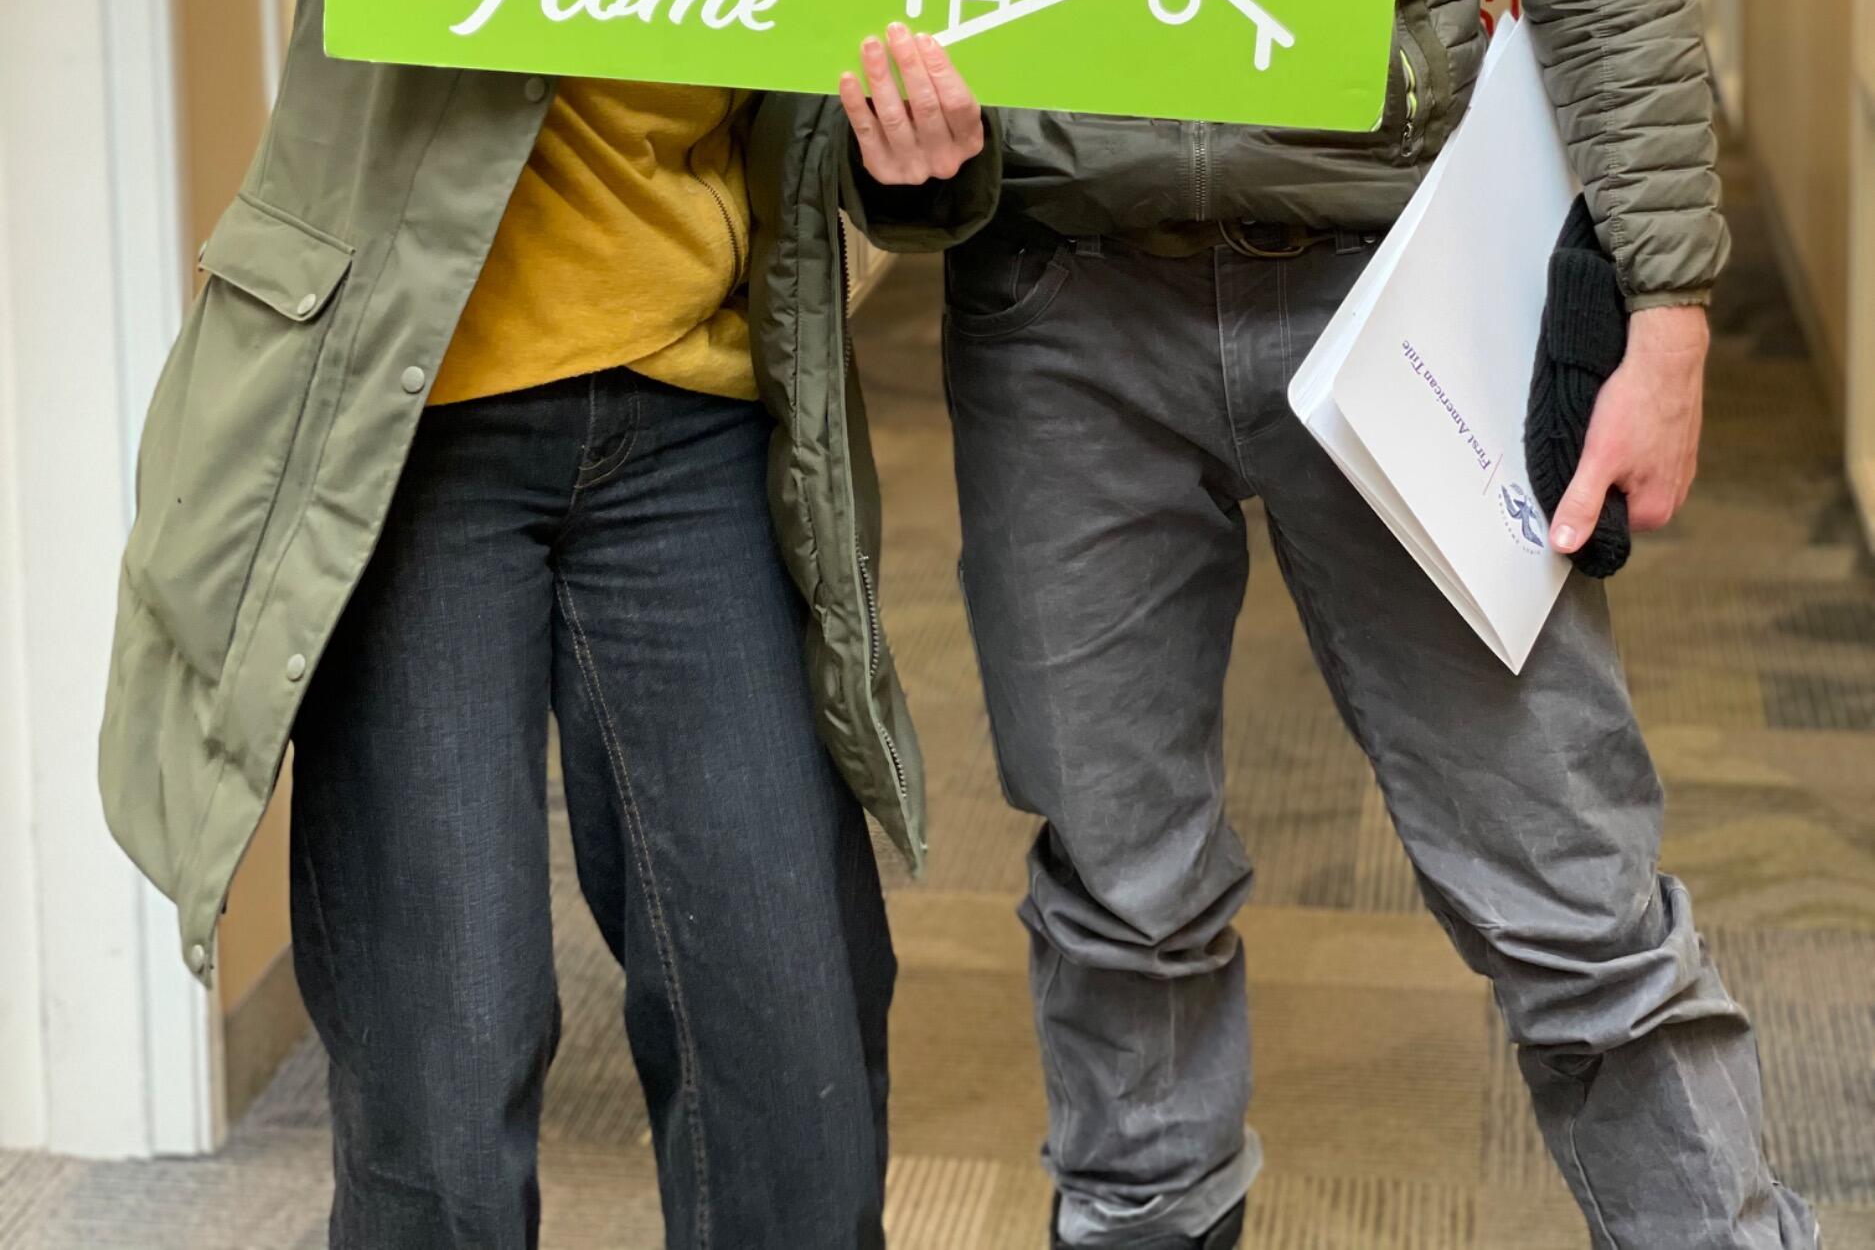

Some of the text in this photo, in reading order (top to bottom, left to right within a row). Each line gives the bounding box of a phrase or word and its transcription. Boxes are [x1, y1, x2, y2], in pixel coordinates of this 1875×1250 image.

[1401, 339, 1492, 470] First American Title
